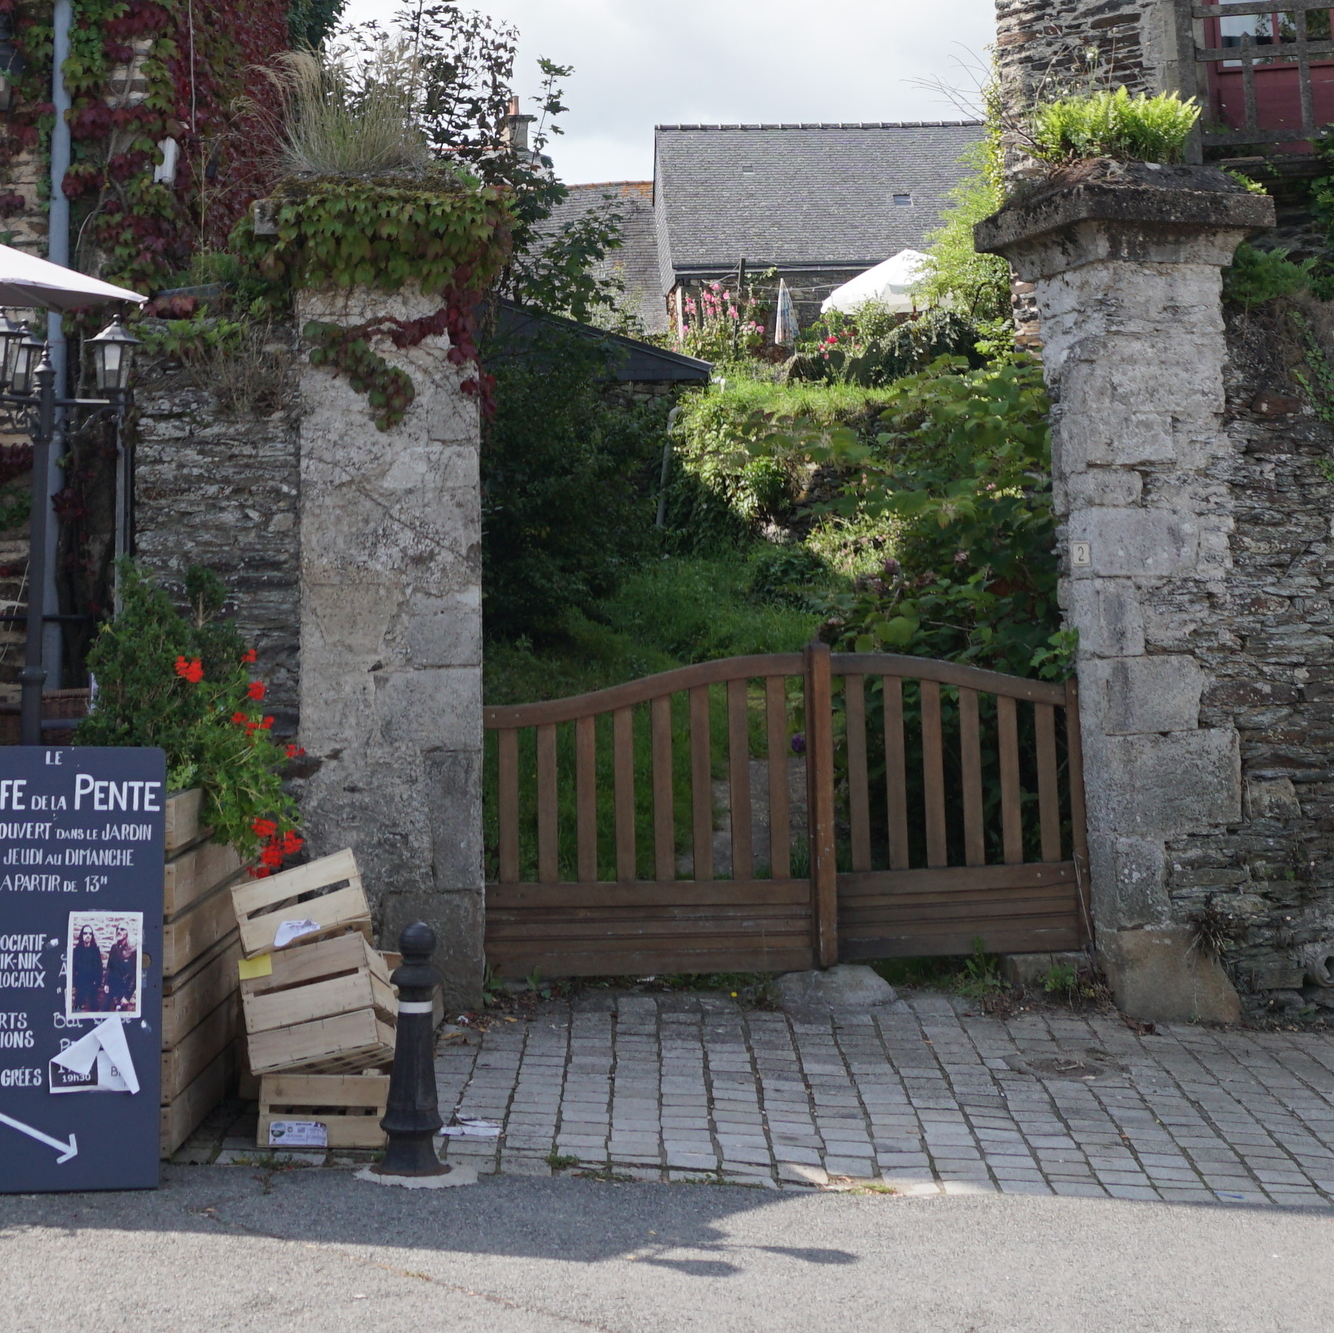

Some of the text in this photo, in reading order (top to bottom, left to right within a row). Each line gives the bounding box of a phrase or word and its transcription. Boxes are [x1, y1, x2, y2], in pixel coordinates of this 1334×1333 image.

[1077, 546, 1085, 562] 2
[45, 750, 63, 765] LE
[31, 795, 48, 810] DE
[51, 795, 67, 811] LA
[74, 773, 162, 812] PENTE
[56, 828, 84, 840] DANS
[86, 828, 98, 840] LE
[101, 823, 152, 841] JARDIN
[3, 848, 43, 866] JEUDI
[44, 853, 62, 866] AU
[65, 847, 134, 867] DIMANCHE
[63, 878, 78, 893] DE
[0, 1066, 43, 1087] GRÉES
[61, 1073, 92, 1083] 19h30
